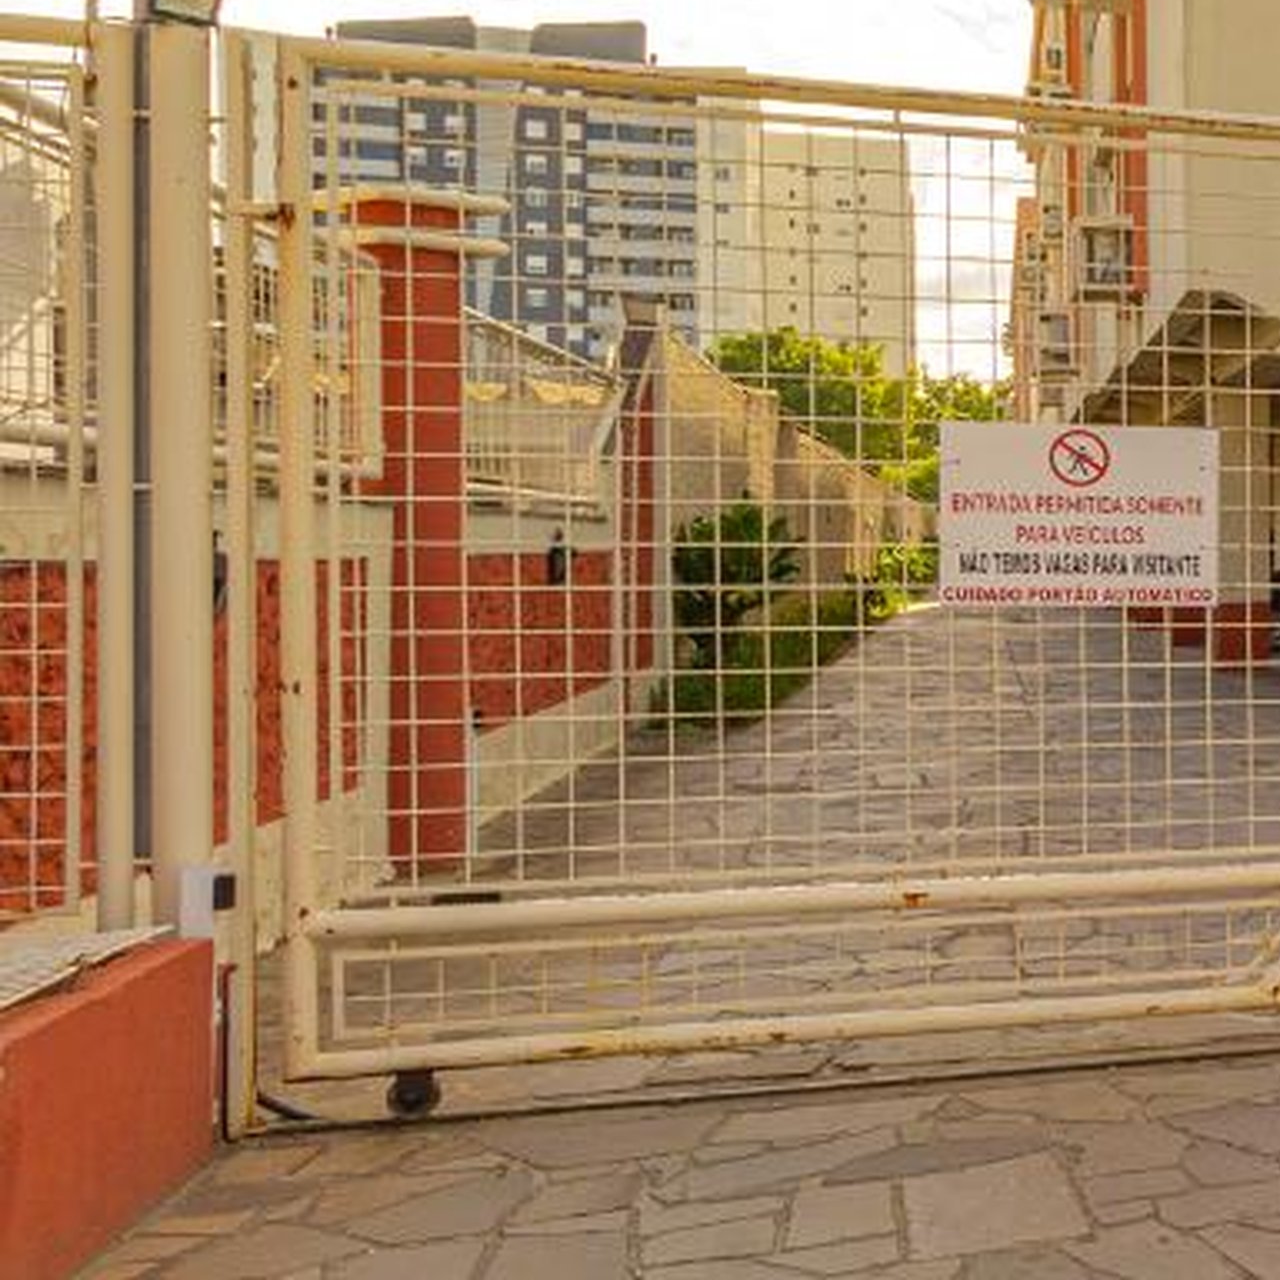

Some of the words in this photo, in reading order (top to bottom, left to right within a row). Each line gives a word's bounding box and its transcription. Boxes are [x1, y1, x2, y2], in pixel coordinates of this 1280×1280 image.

[952, 492, 1032, 513] ENTRADA
[1035, 495, 1123, 514] PERMITIDA
[1126, 496, 1202, 516] SOMENTE
[1016, 525, 1059, 543] PARA
[993, 552, 1041, 574] TEMOS
[1044, 552, 1090, 575] VAGAS
[1092, 553, 1127, 575] PARA
[1130, 554, 1201, 577] VISITANTE
[943, 586, 1023, 601] CUIDADO
